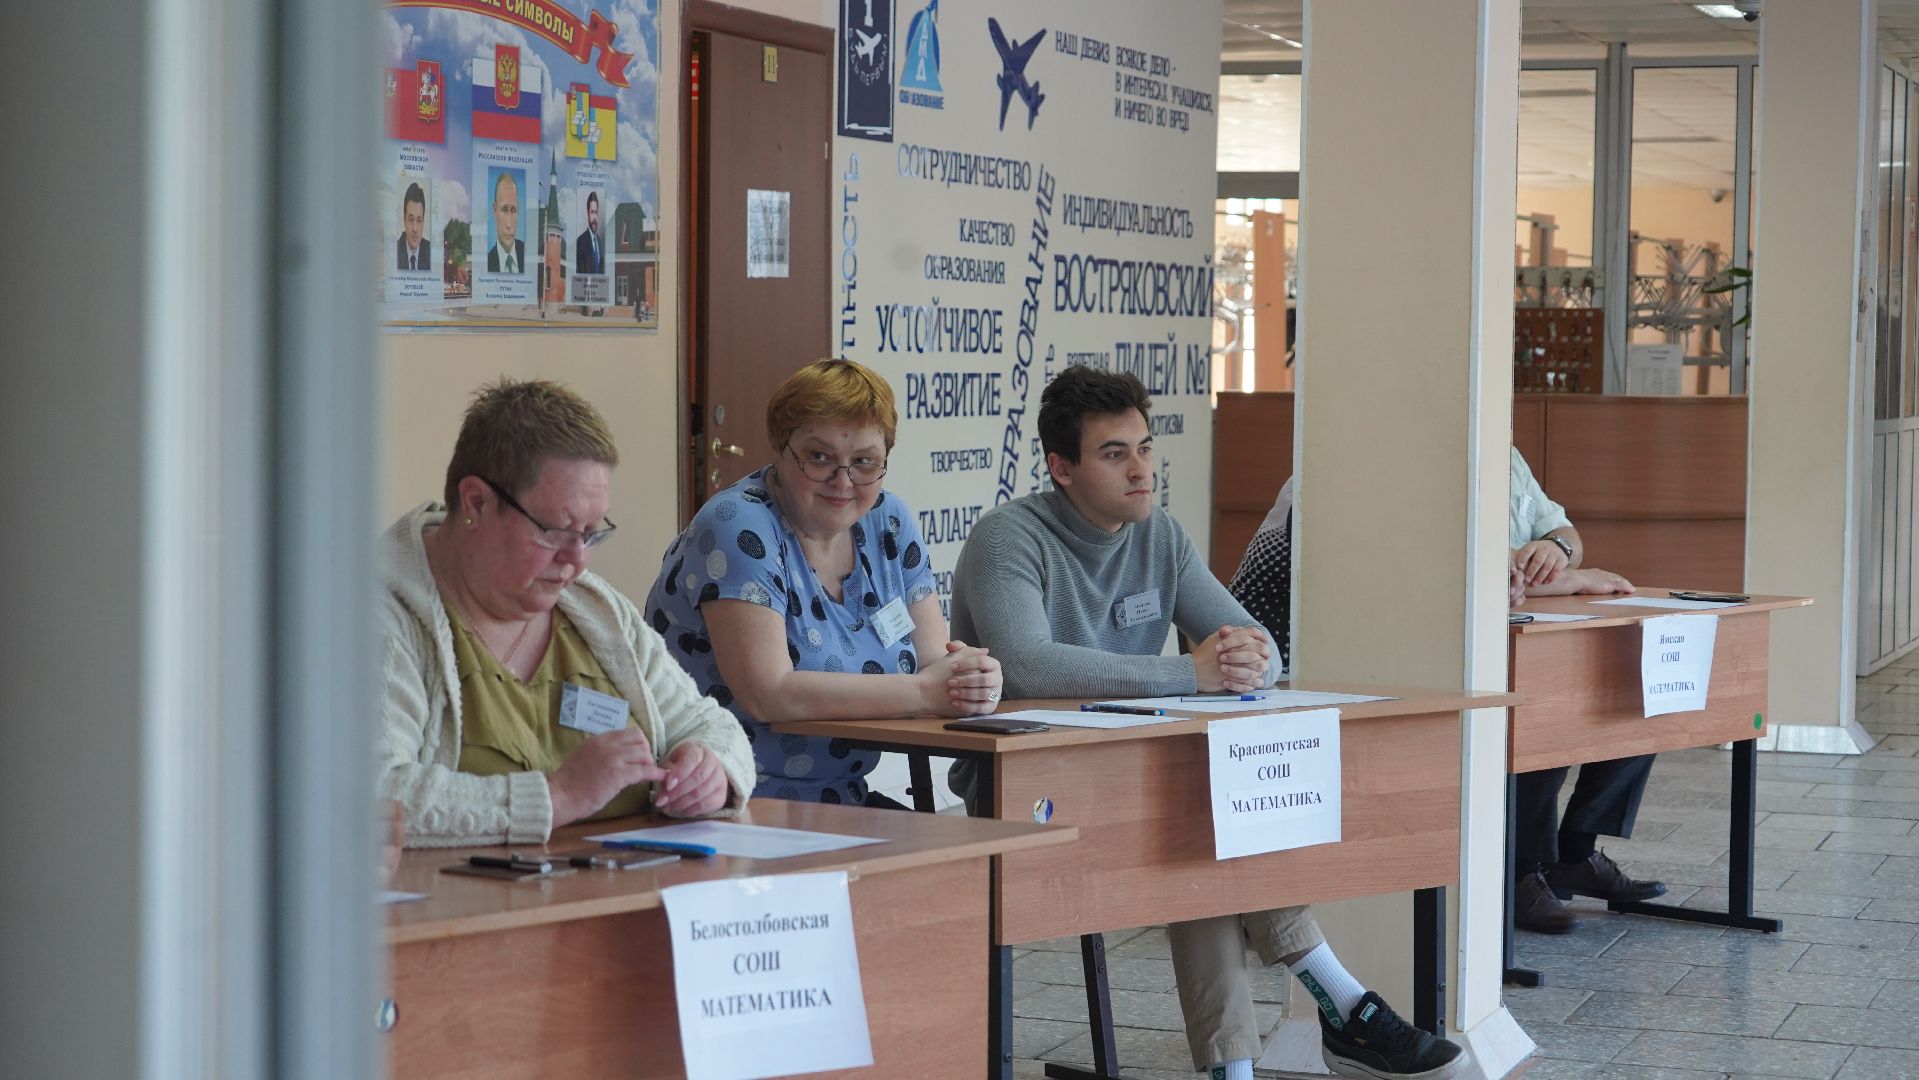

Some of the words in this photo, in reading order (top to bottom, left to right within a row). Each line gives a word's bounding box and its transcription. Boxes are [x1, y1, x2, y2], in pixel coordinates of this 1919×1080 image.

[506, 0, 575, 43] СИМВОЛЫ
[1056, 31, 1078, 56] НАШ
[1081, 37, 1110, 64] ДЕВИЗ
[1116, 46, 1148, 72] ВСЯКОЕ
[1149, 54, 1171, 77] ДЕЛО
[1116, 72, 1122, 92] В
[1115, 97, 1122, 118] И
[1124, 100, 1154, 125] НИЧЕГО
[1156, 106, 1168, 127] ВО
[898, 143, 1032, 192] СОТРУДНИЧЕСТВО
[1063, 193, 1194, 238] ИНДИВИДУАЛЬНОСТЬ
[960, 218, 1015, 247] КАЧЕСТВО
[842, 152, 859, 360] ПНОСТЬ
[925, 254, 1006, 285] ОБРАЗОВАНИЯ
[1054, 253, 1216, 318] ВОСТРЯКОВСКИЙ
[876, 297, 1004, 354] УСТОЙЧИВОЕ
[906, 371, 1003, 419] РАЗВИТИЕ
[930, 448, 993, 473] ТВОРЧЕСТВО
[919, 505, 984, 545] ТАЛАНТ
[1660, 634, 1685, 645] Ямская
[1661, 651, 1680, 663] СОШ
[1229, 737, 1320, 761] Краснопутская
[1257, 763, 1291, 781] СОШ
[1232, 791, 1322, 813] МАТЕМАТИКА
[690, 913, 830, 941] Белостолбовская
[733, 950, 781, 975] СОШ
[1301, 974, 1321, 993] ONLY
[701, 988, 833, 1018] МАТЕМАТИКА
